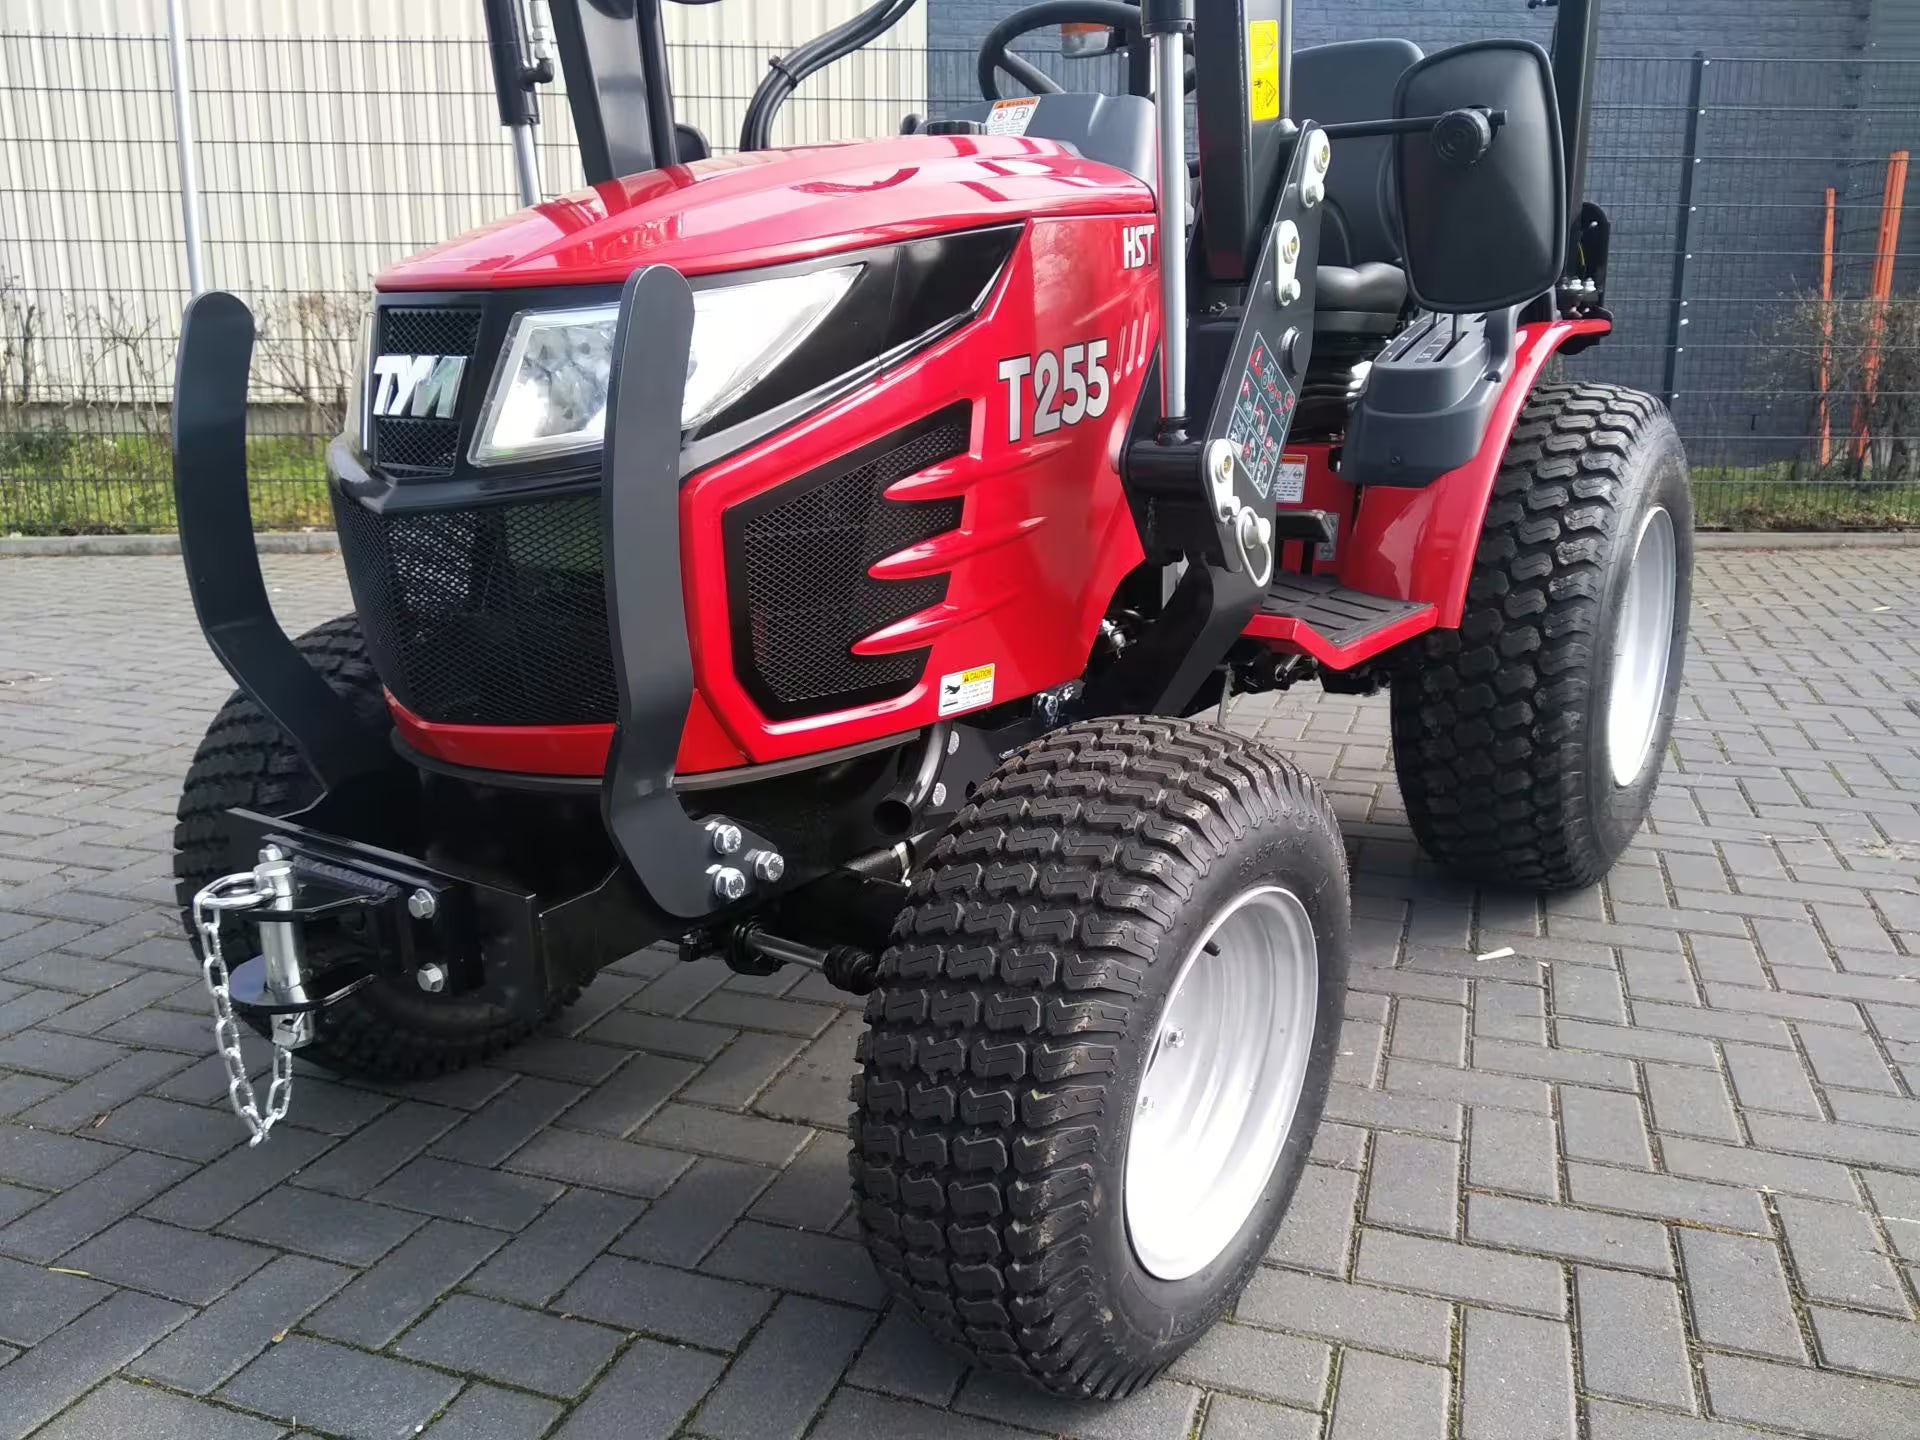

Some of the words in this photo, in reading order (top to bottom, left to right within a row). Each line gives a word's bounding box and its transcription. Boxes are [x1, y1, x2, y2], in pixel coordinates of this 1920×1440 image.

[1122, 224, 1156, 269] HST
[373, 354, 468, 419] TYM
[998, 338, 1110, 443] T255
[969, 667, 993, 681] CAUTION
